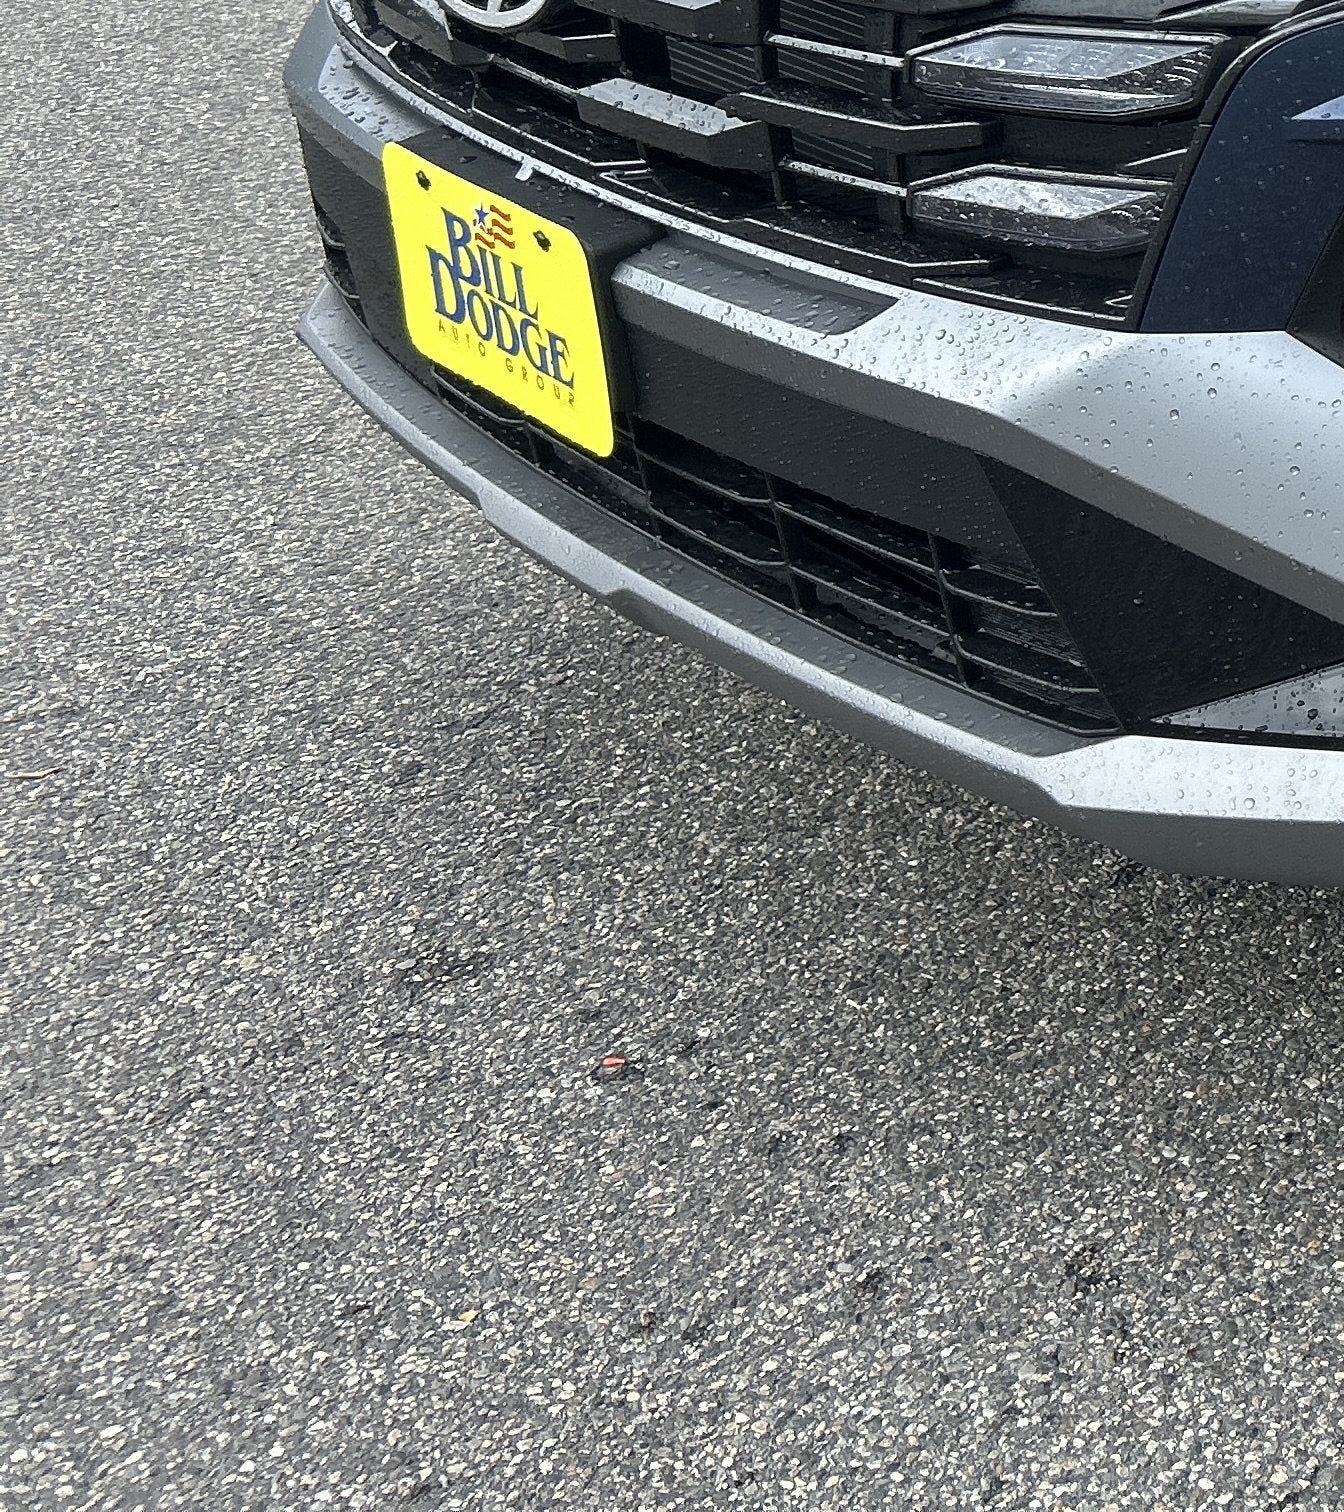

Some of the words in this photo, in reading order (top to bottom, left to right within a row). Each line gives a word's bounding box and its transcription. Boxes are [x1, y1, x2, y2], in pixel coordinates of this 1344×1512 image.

[425, 245, 575, 389] DODGE
[441, 206, 539, 321] BILL
[438, 319, 487, 358] AUTO
